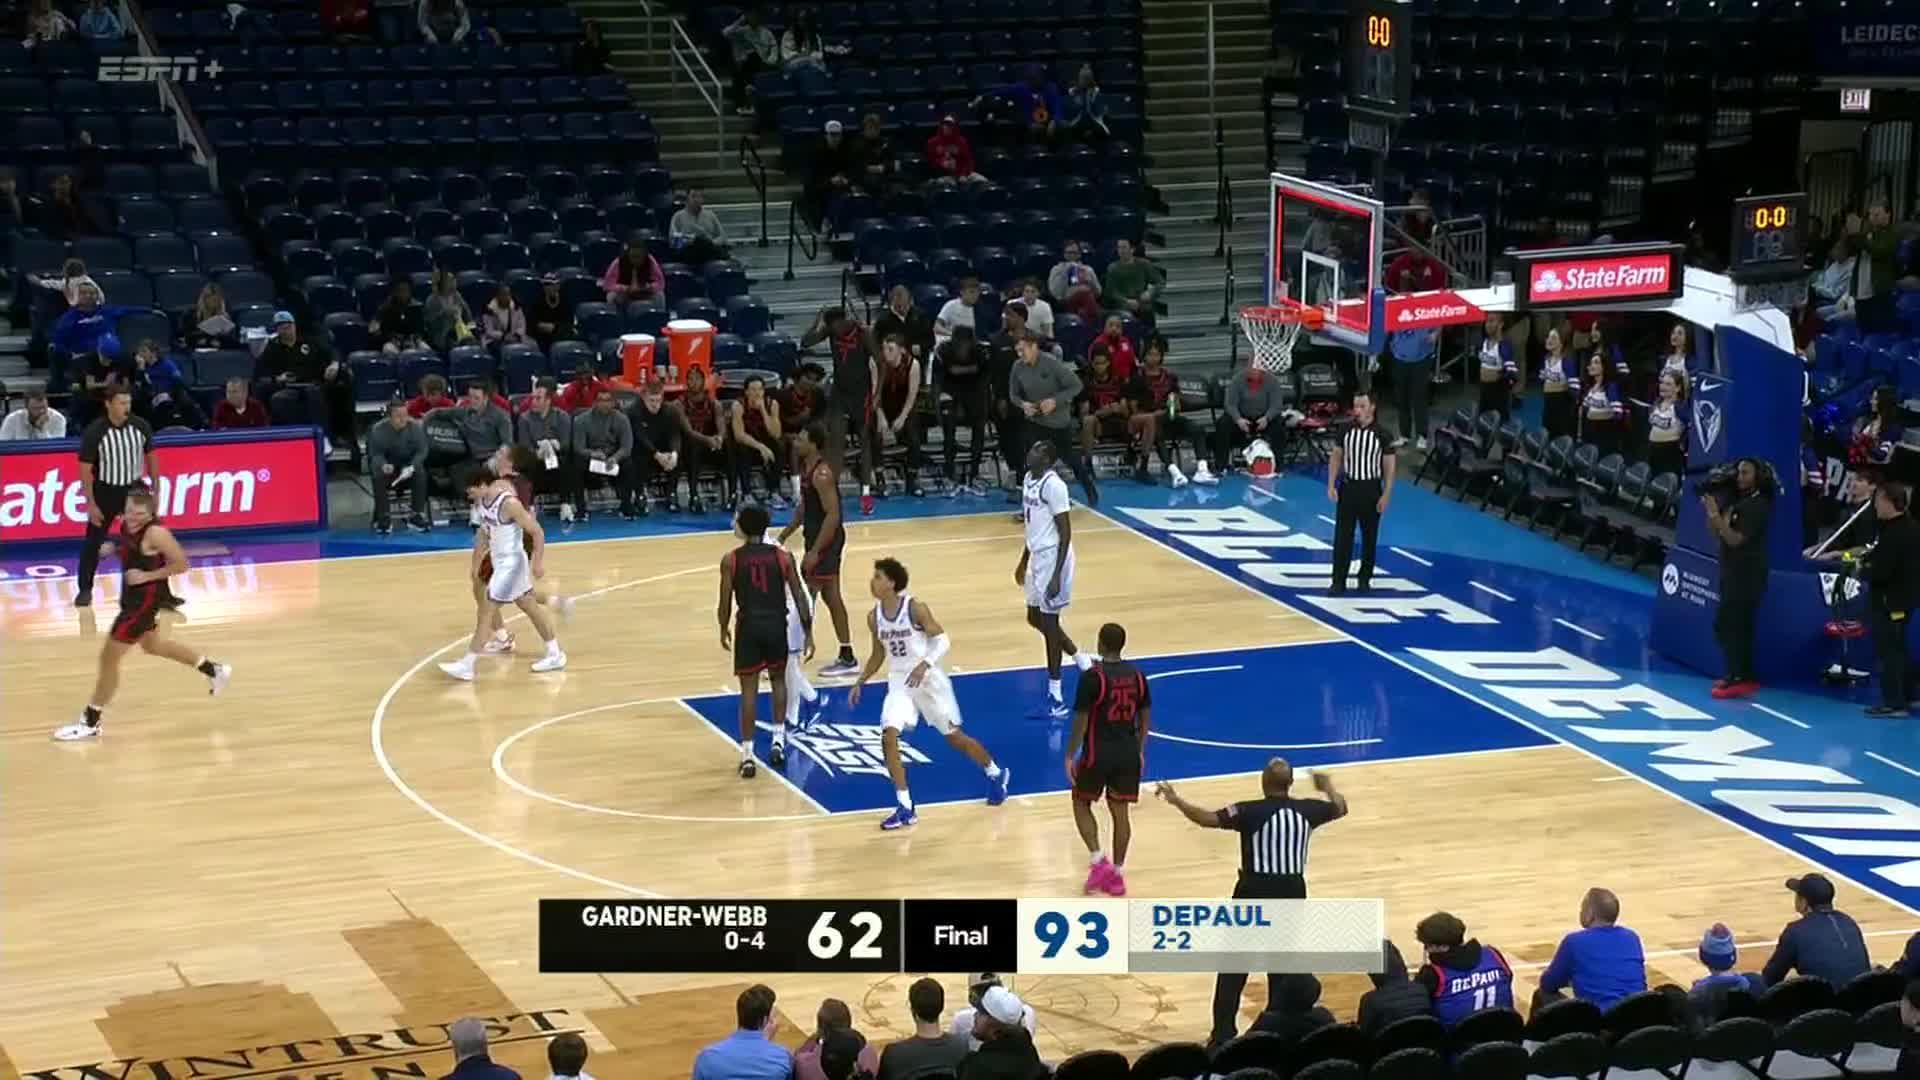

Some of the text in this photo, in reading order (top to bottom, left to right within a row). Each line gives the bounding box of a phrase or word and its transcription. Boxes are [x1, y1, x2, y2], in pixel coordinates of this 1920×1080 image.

[751, 560, 769, 593] 4
[889, 640, 907, 657] 22
[1107, 687, 1137, 721] 25
[1473, 985, 1497, 1011] 11
